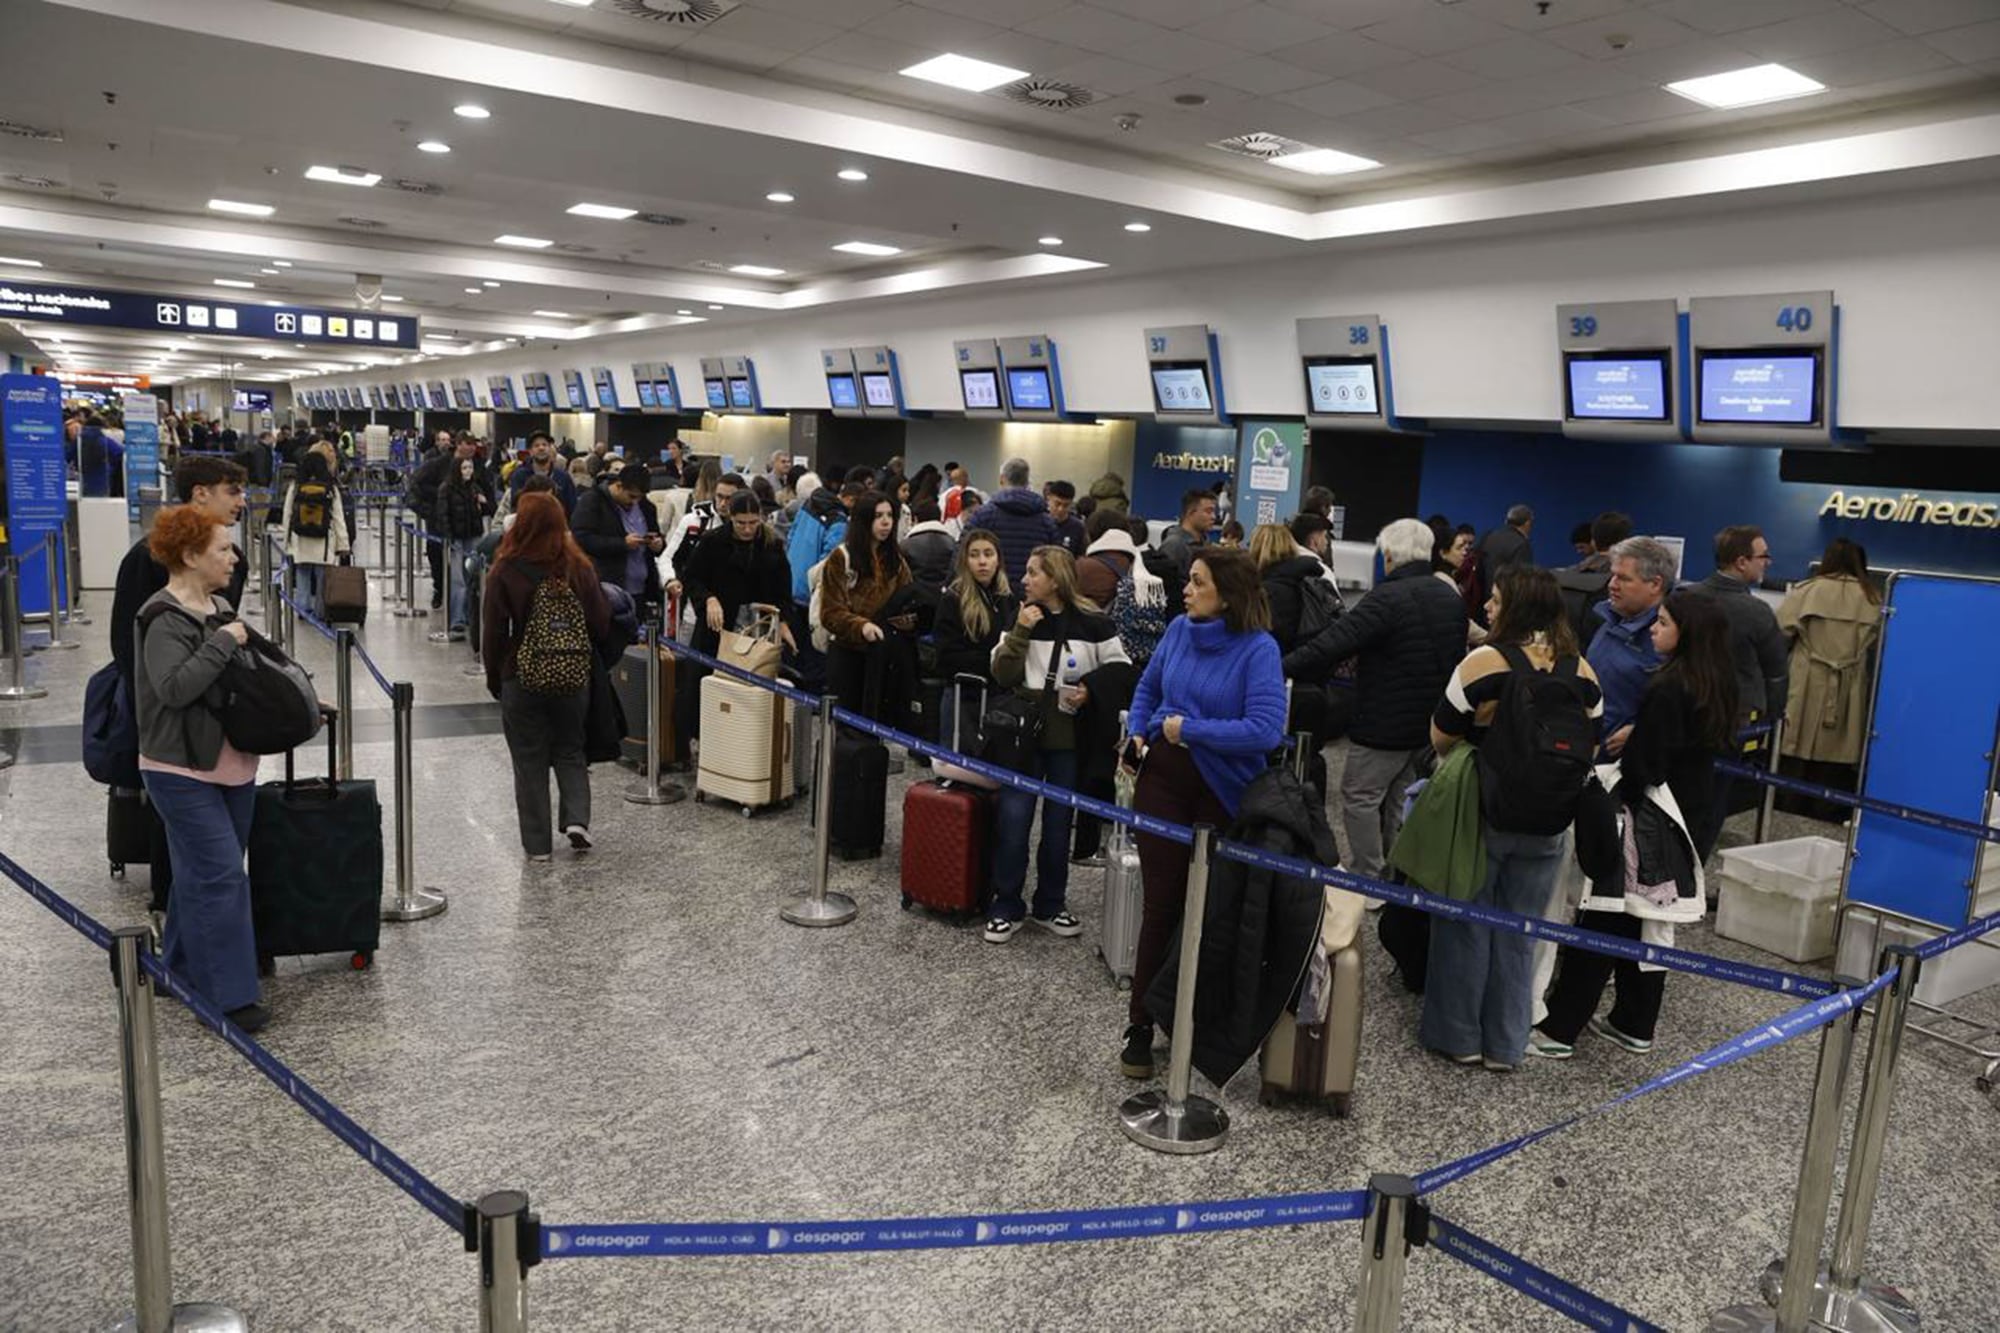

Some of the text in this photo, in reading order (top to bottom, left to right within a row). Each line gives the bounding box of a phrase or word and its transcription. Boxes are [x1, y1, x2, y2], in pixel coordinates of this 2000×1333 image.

[1570, 316, 1597, 336] 39
[1776, 306, 1812, 331] 40
[1350, 327, 1369, 345] 38
[1150, 337, 1166, 352] 37
[1662, 953, 1707, 969] despegar
[1200, 1208, 1266, 1222] despegar
[1001, 1222, 1071, 1236] despegar
[1082, 1222, 1107, 1231] HOLA
[1111, 1219, 1140, 1229] HELLO
[575, 1234, 756, 1248] despegar HOLA HELLO CIAO
[793, 1230, 866, 1244] despegar
[1450, 1236, 1514, 1276] despegar
[1525, 1276, 1551, 1295] HOLA
[1554, 1293, 1586, 1313] HELLO
